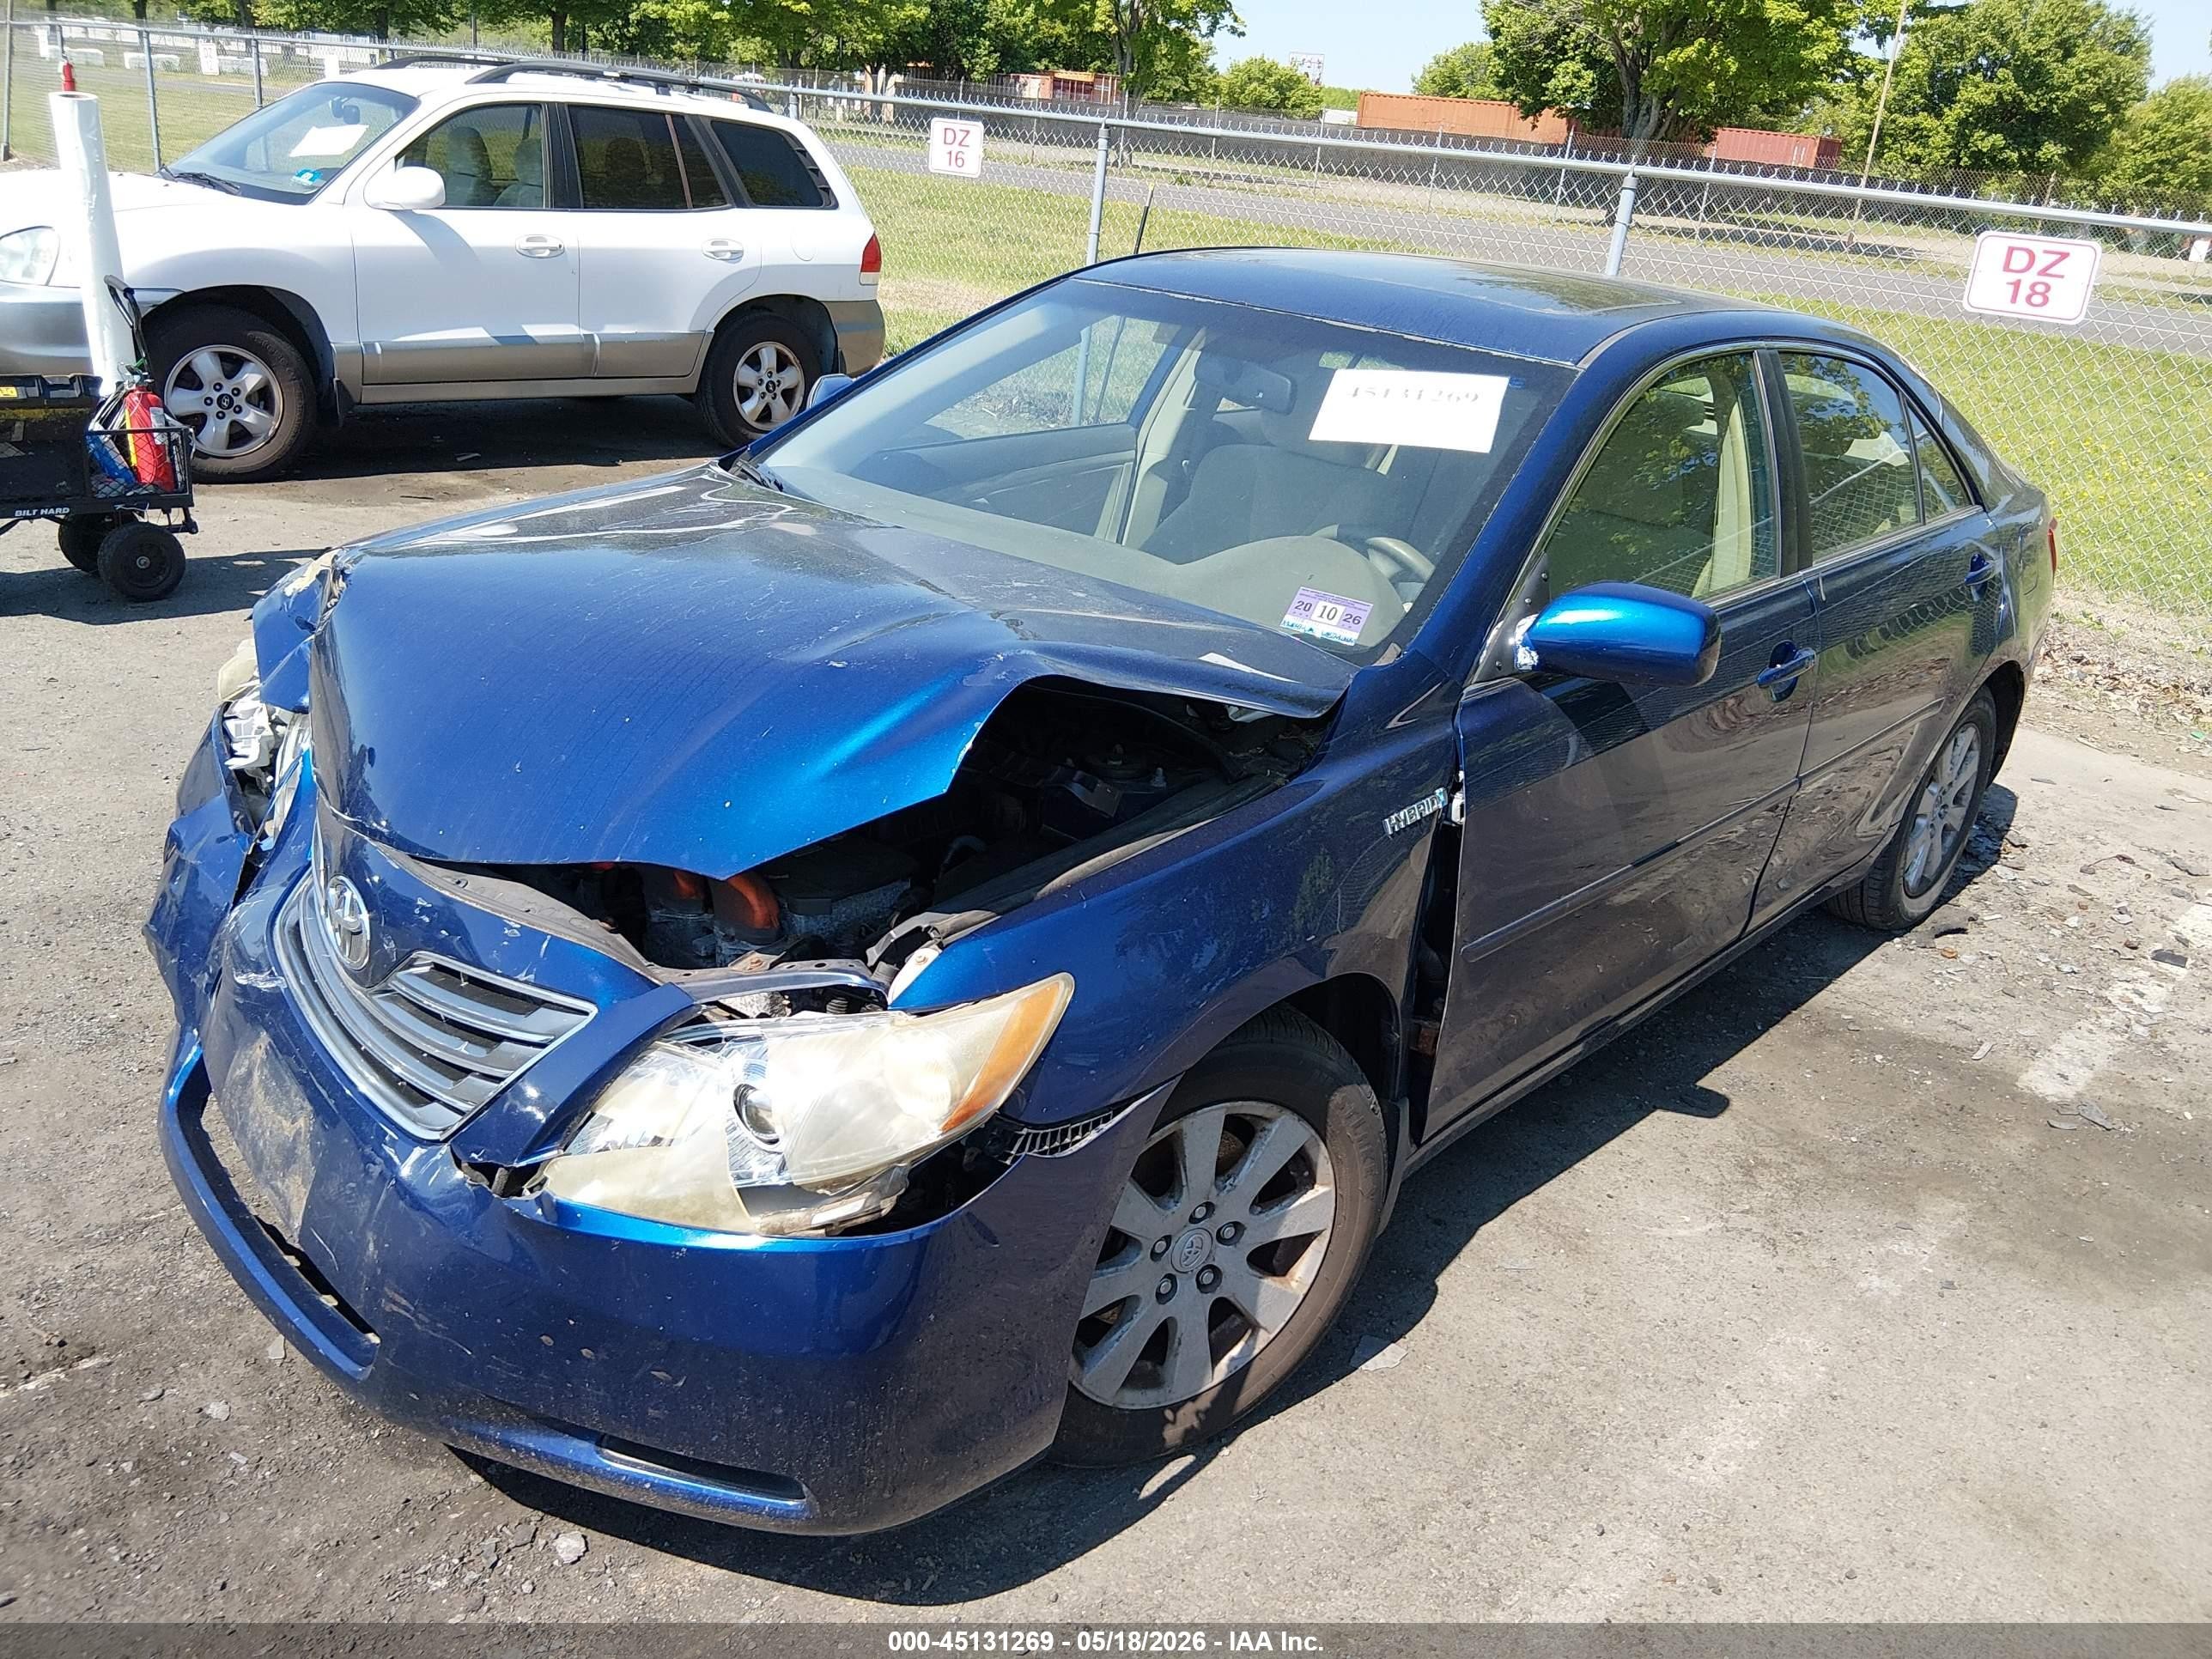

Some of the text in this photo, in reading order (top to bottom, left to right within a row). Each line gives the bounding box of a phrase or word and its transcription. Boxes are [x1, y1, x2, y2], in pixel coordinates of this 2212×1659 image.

[944, 127, 970, 147] DZ
[946, 150, 965, 168] 16
[2002, 246, 2070, 278] DZ
[2006, 278, 2051, 307] 18
[1294, 600, 1363, 625] 20 10 26
[1383, 793, 1442, 836] HYBRID
